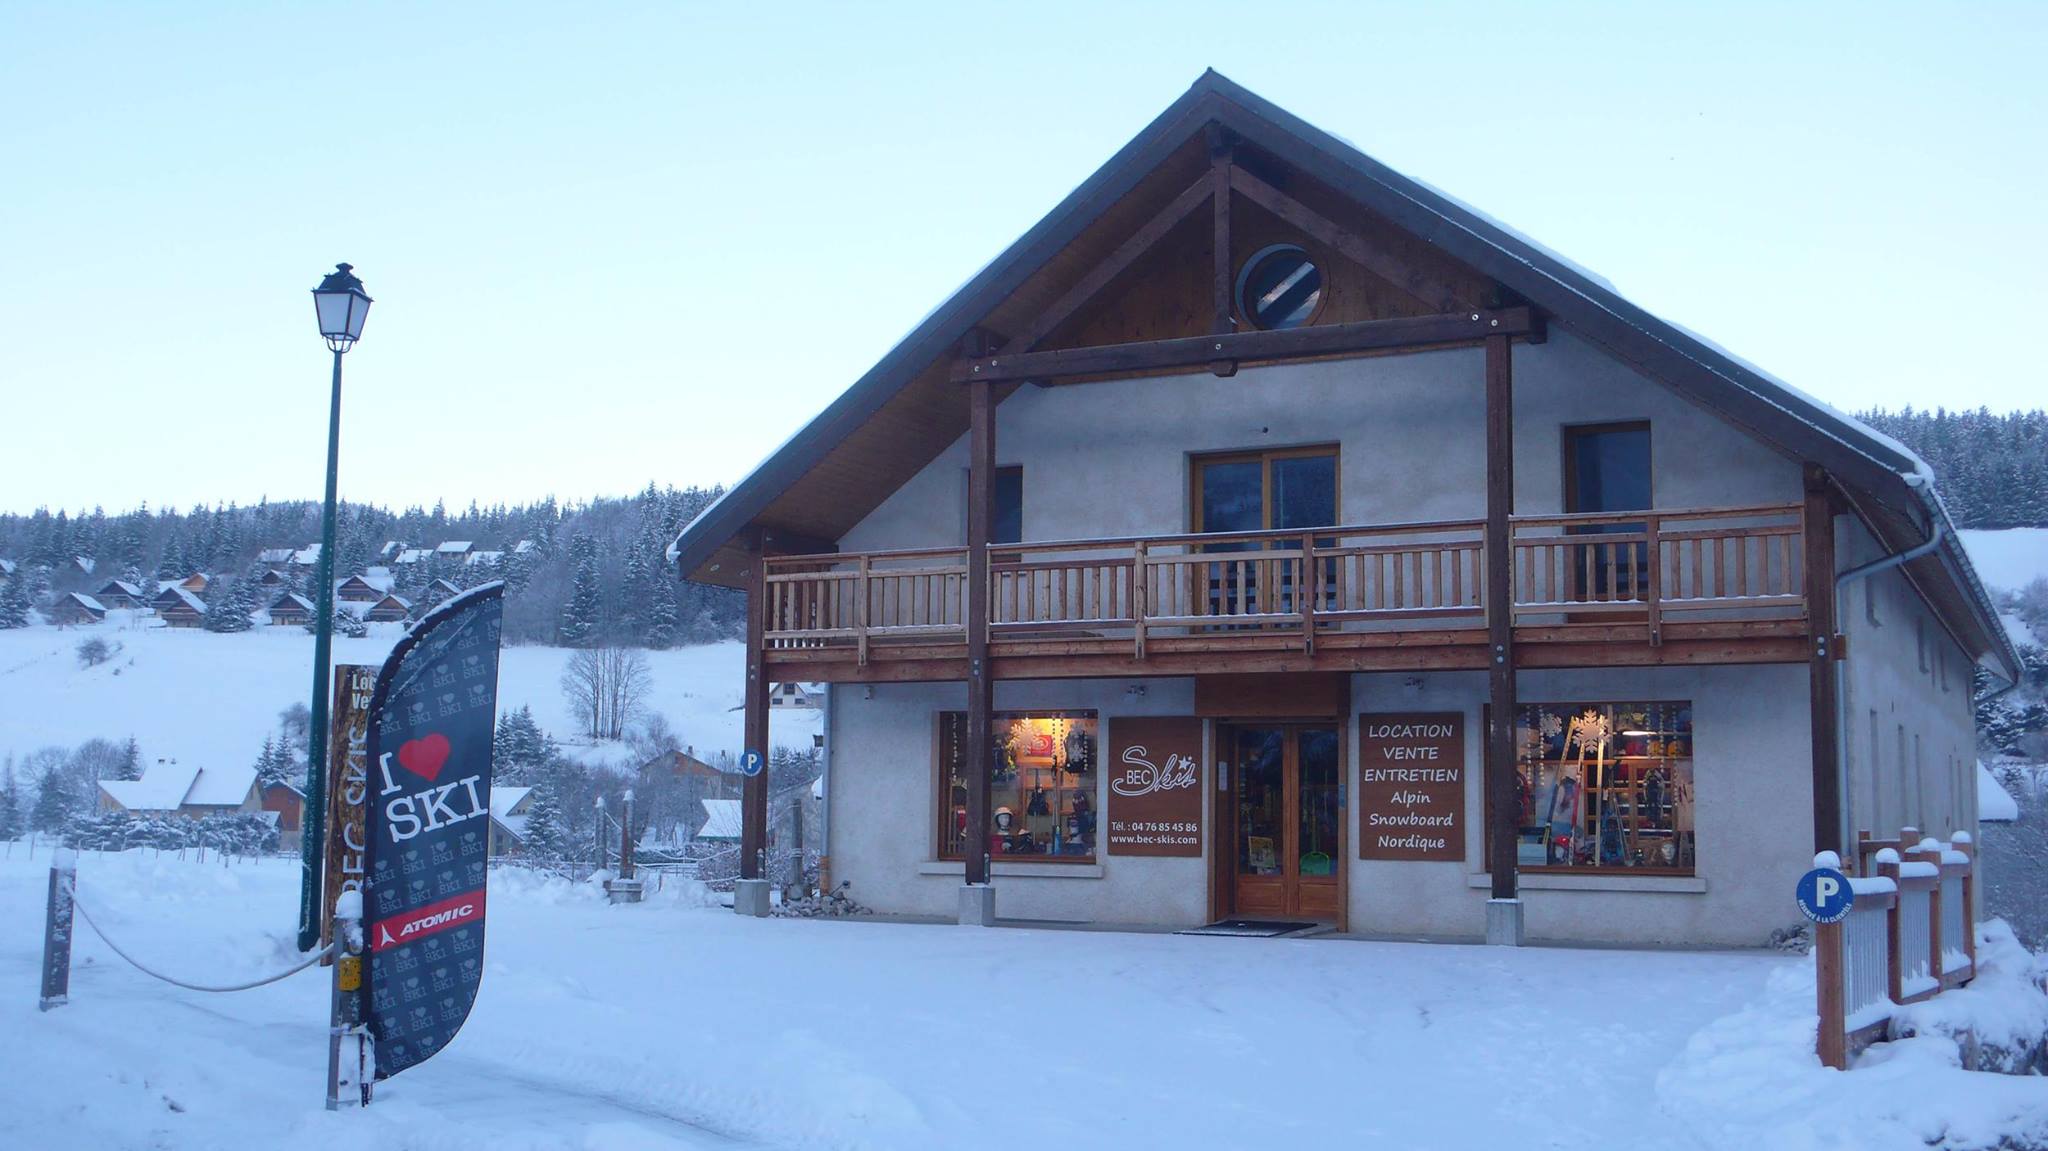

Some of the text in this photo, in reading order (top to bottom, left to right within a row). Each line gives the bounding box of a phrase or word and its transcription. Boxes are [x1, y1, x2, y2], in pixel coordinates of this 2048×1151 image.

[352, 693, 375, 710] Ve
[1369, 725, 1453, 738] LOCATION
[747, 753, 758, 769] P
[1383, 746, 1439, 760] VENTE
[379, 752, 402, 796] I
[1112, 745, 1197, 796] BEC Skis
[1364, 768, 1459, 782] ENTRETIEN
[1390, 790, 1431, 808] Alpin
[386, 774, 489, 844] SKI
[1132, 822, 1143, 831] 04
[1145, 822, 1157, 832] 76
[1158, 823, 1170, 832] 85
[1172, 823, 1184, 832] 45
[1185, 823, 1198, 832] 86
[1369, 812, 1453, 826] Snowboard
[1111, 834, 1197, 845] www.bec-skis.com
[1378, 834, 1446, 852] Nordique
[1816, 877, 1840, 907] P
[400, 904, 473, 937] ATOMIC
